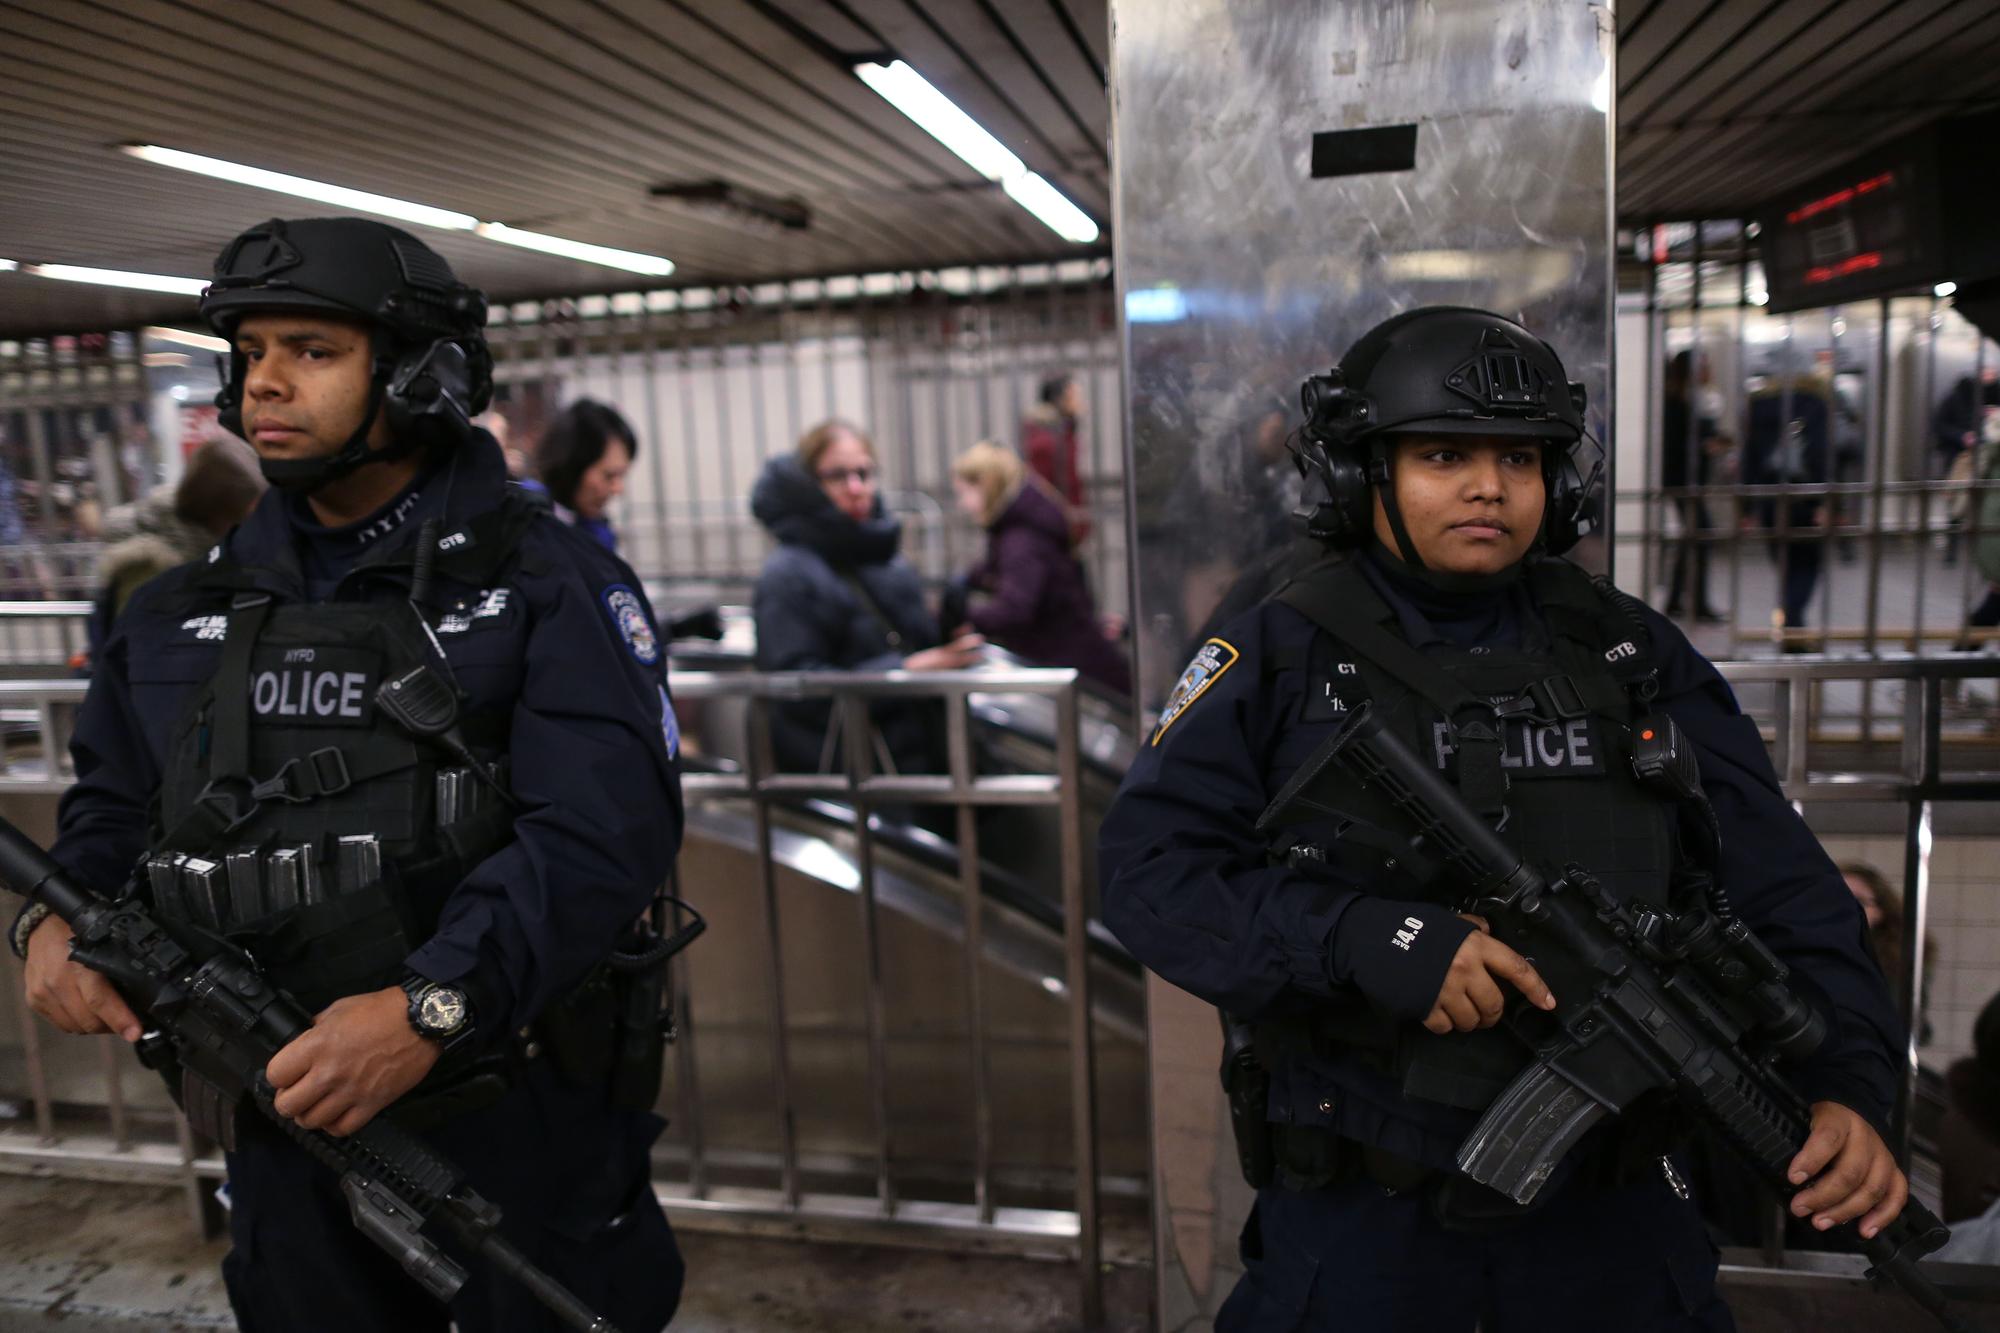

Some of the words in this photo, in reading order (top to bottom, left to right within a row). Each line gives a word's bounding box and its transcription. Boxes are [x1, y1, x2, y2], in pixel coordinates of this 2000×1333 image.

[284, 648, 316, 663] NYPD
[1605, 641, 1637, 662] CTB
[1337, 663, 1357, 675] CT
[250, 670, 367, 717] OLICE
[1433, 718, 1595, 769] PLICE
[1395, 916, 1425, 945] 4.0
